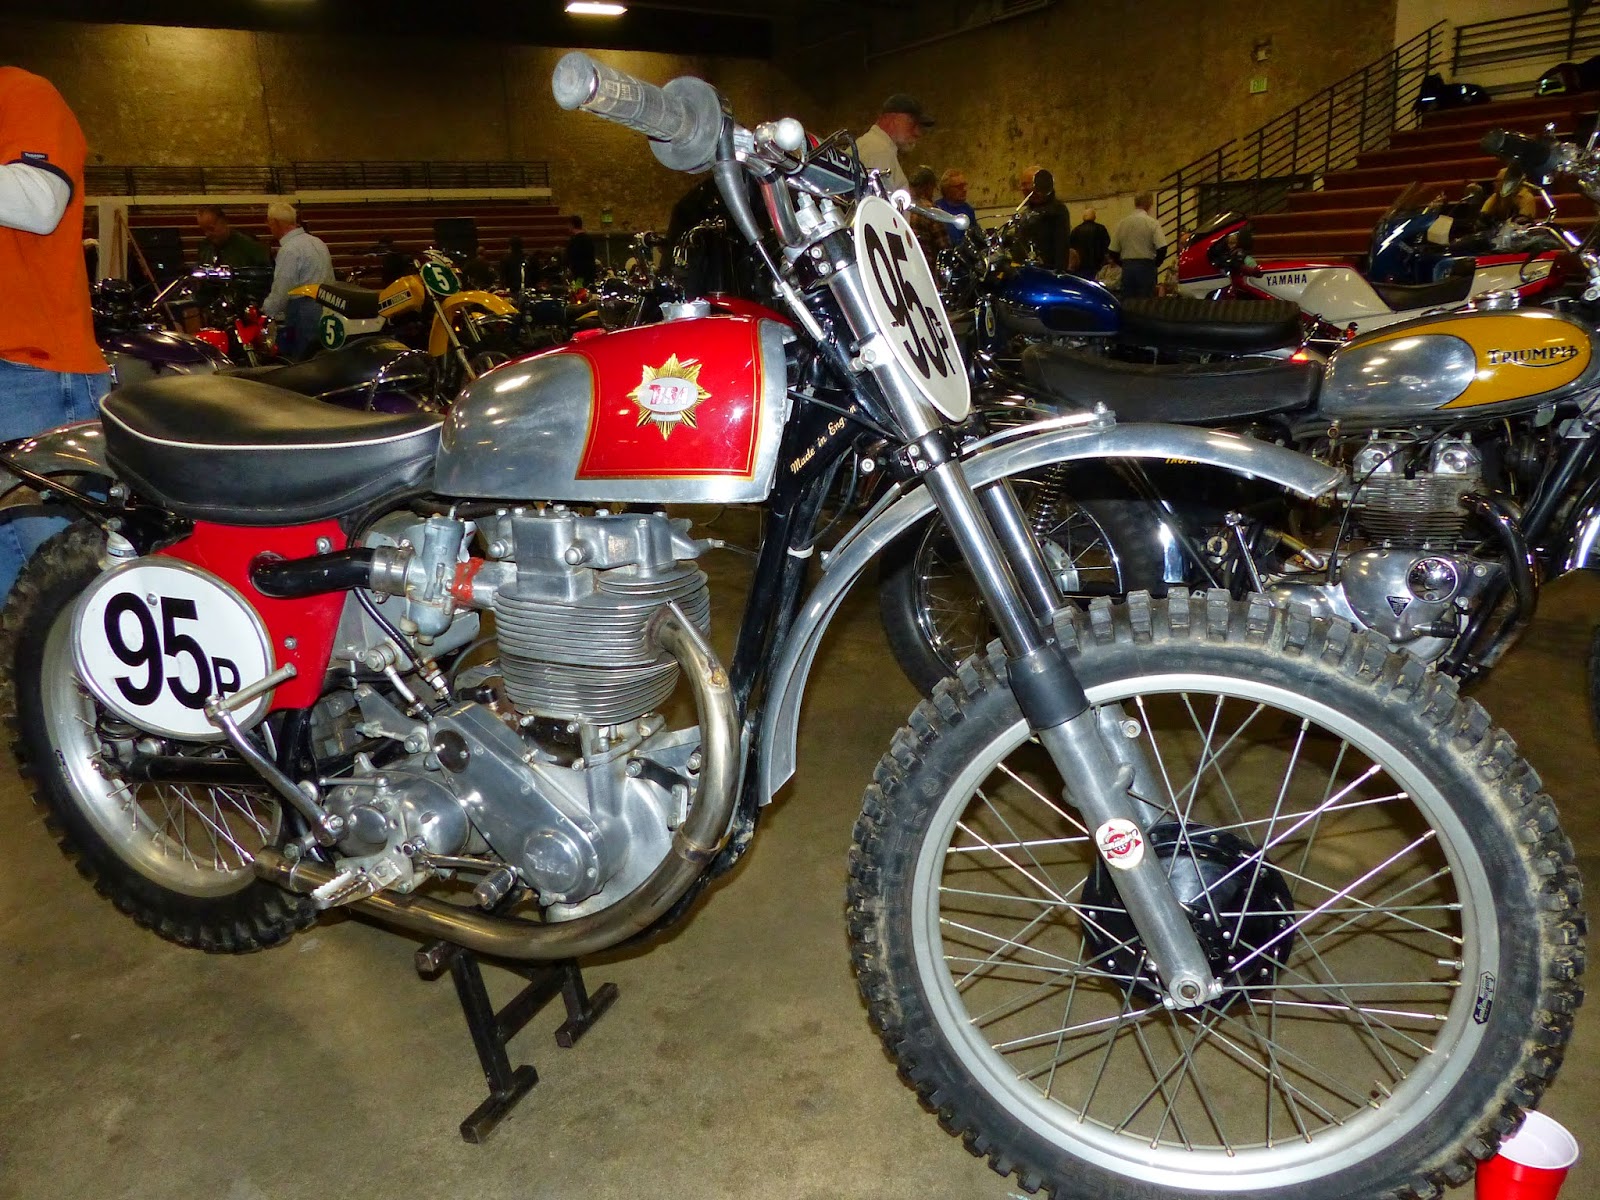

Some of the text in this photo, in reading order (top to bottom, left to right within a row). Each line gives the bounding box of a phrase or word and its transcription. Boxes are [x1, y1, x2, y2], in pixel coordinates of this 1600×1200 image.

[432, 267, 449, 291] 5
[1266, 273, 1308, 286] YAMAHA
[317, 288, 346, 310] YAMAHA
[325, 319, 336, 346] 5
[1486, 345, 1579, 367] TRIUMPH
[648, 384, 690, 405] BSA
[789, 447, 816, 474] Made
[816, 435, 828, 448] in
